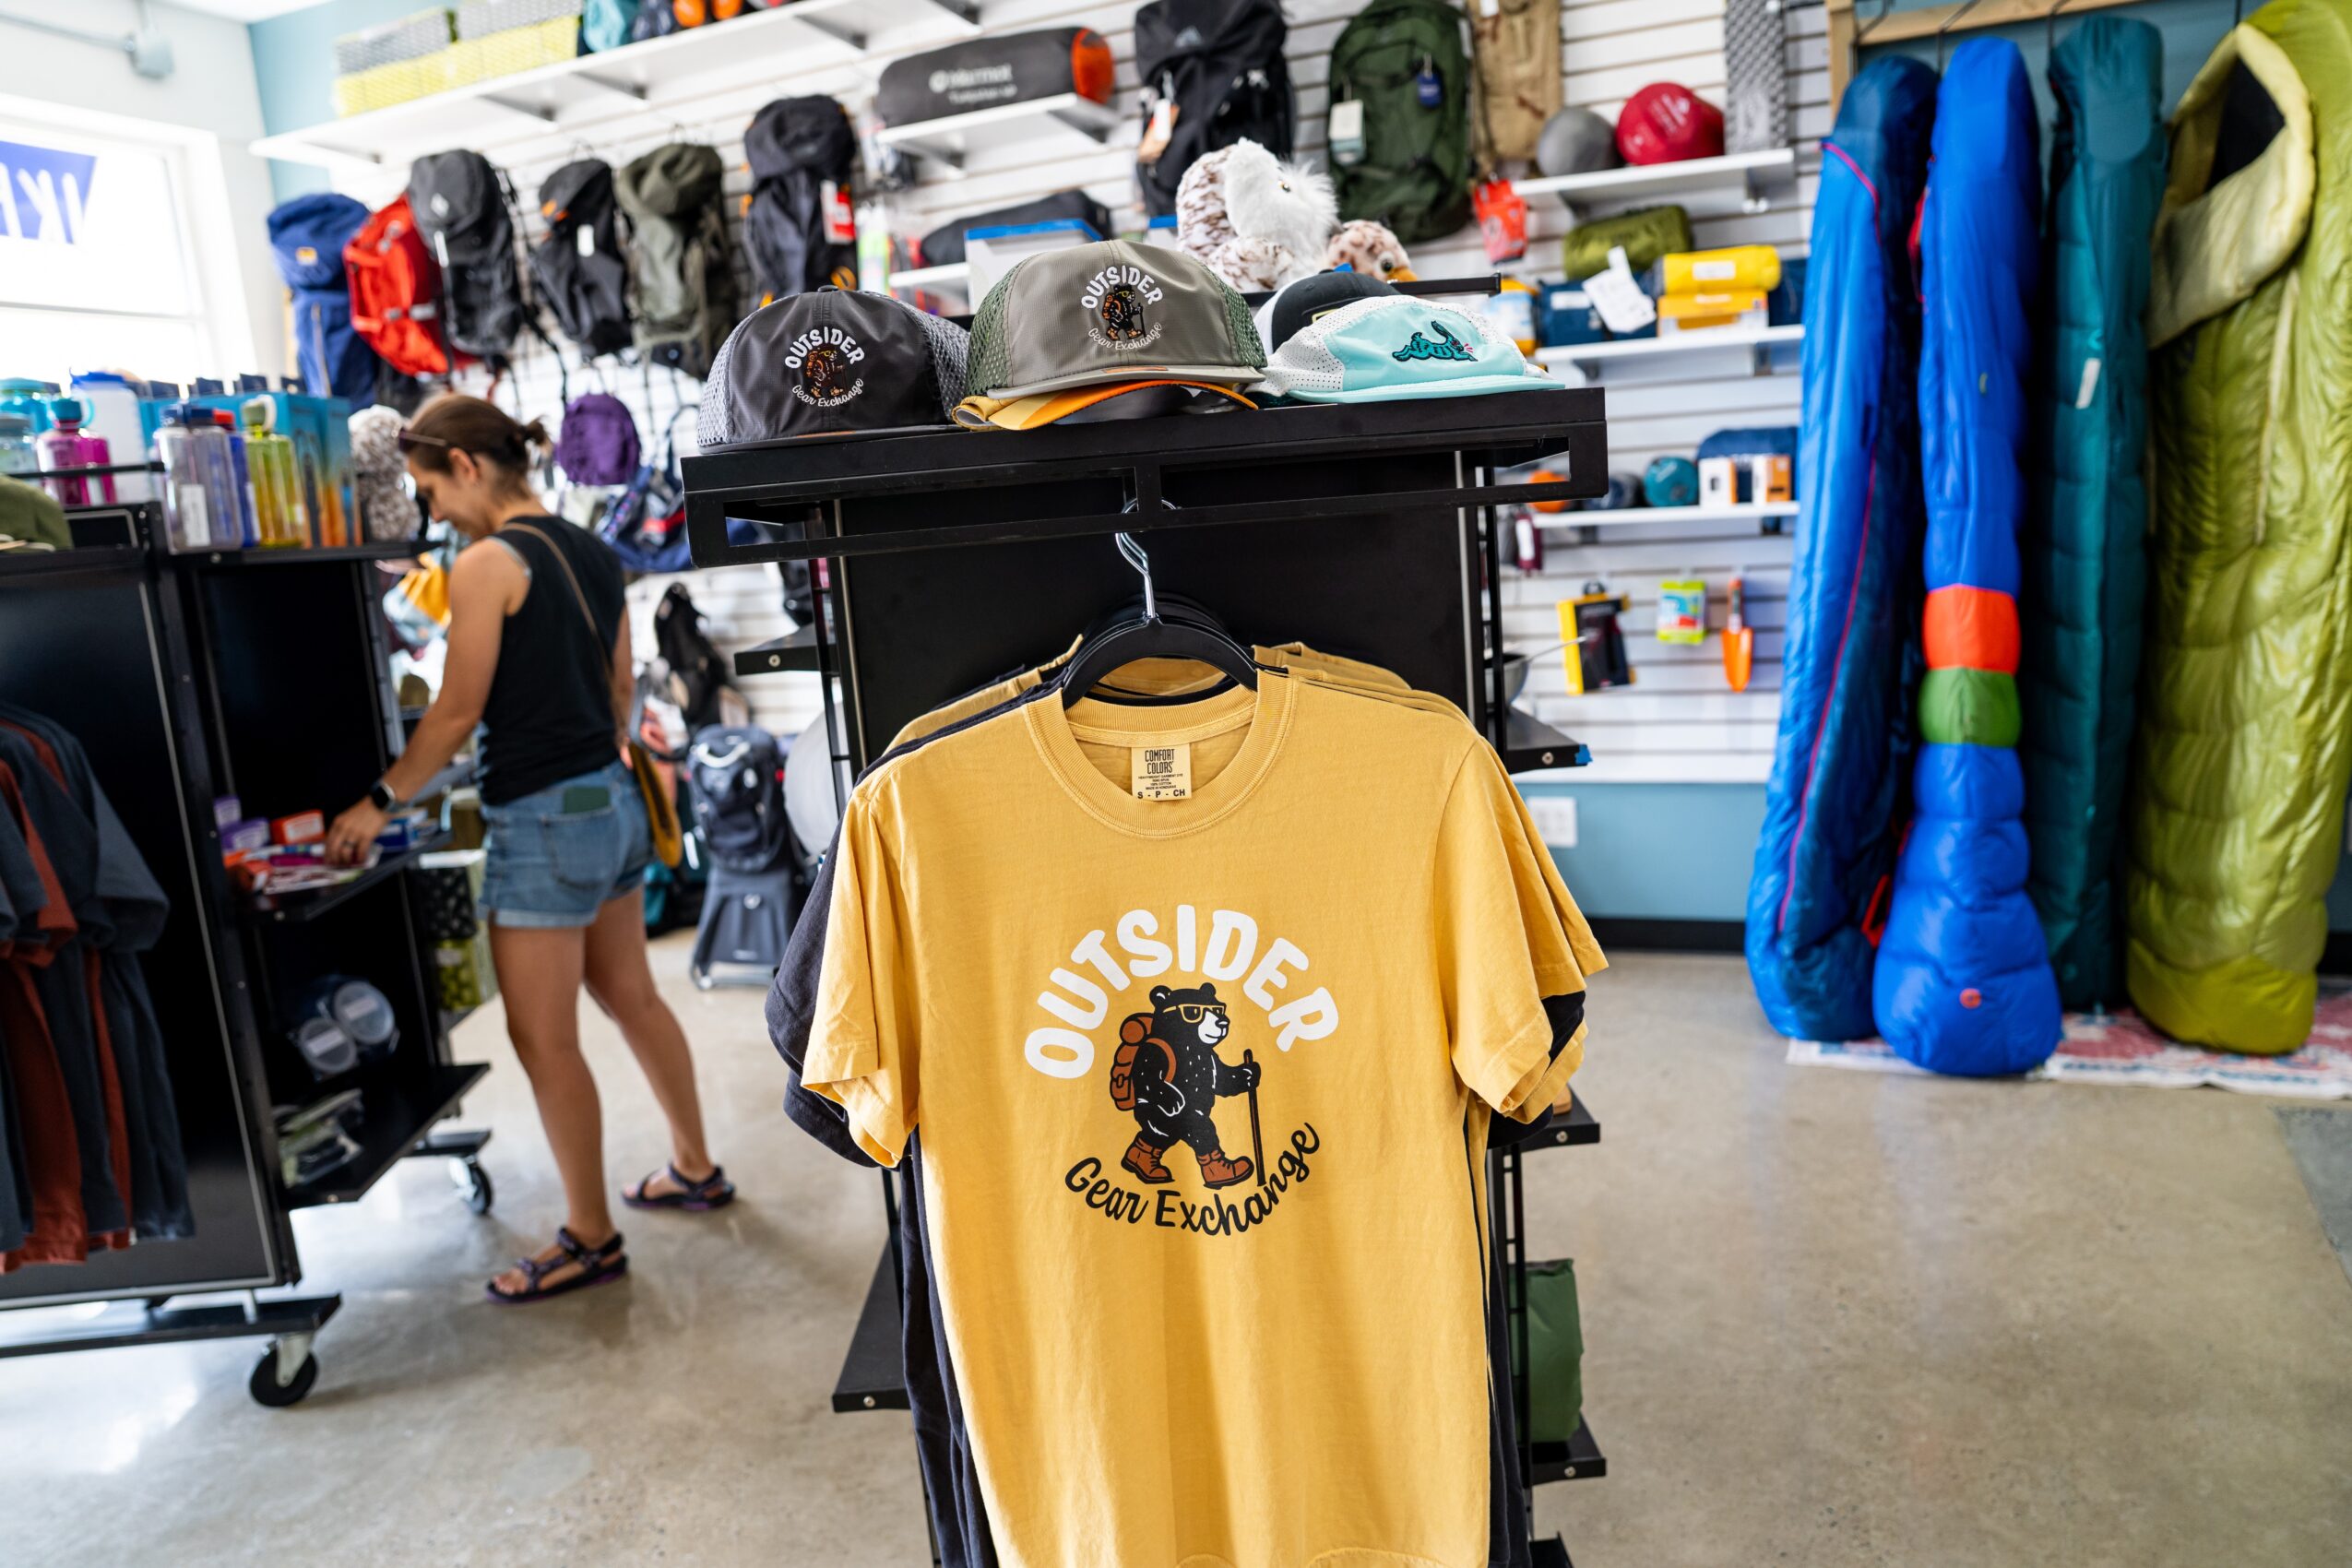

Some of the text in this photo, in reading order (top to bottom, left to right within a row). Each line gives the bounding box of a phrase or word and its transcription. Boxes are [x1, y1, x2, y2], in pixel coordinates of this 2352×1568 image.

[1081, 265, 1163, 308] OUTSIDER
[785, 327, 865, 369] OUTSIDER
[1088, 322, 1162, 350] Gear Exchange
[791, 378, 863, 407] Gear Exchange
[1145, 749, 1174, 762] COMFORT
[1024, 904, 1339, 1079] OUTSIDER
[1064, 1122, 1321, 1236] Gear Exchange
